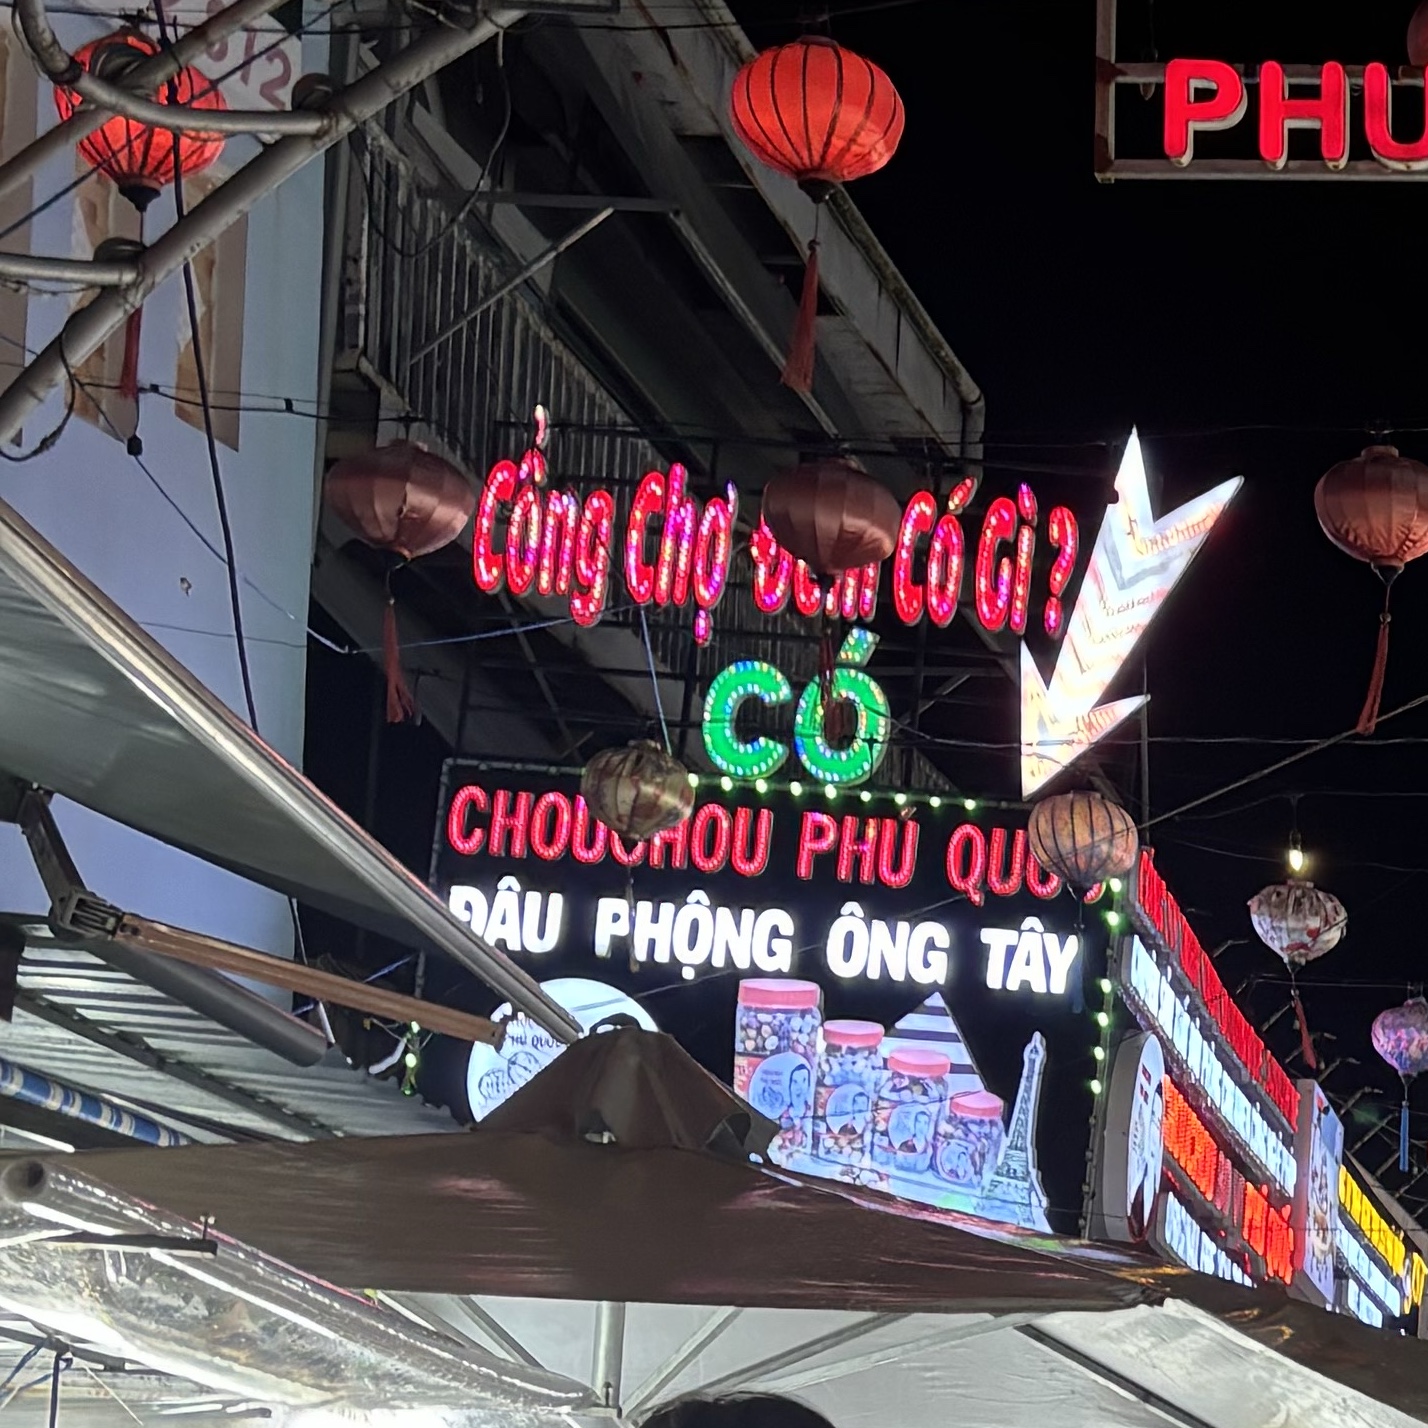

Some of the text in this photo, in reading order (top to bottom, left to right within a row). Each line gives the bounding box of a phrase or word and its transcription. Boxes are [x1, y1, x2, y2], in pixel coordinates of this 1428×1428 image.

[624, 461, 737, 645] Chợ
[894, 476, 978, 628] Có
[701, 626, 891, 787] CÓ
[594, 889, 795, 981] PHỘNG
[825, 901, 950, 985] ÔNG
[979, 916, 1079, 995] TÂY
